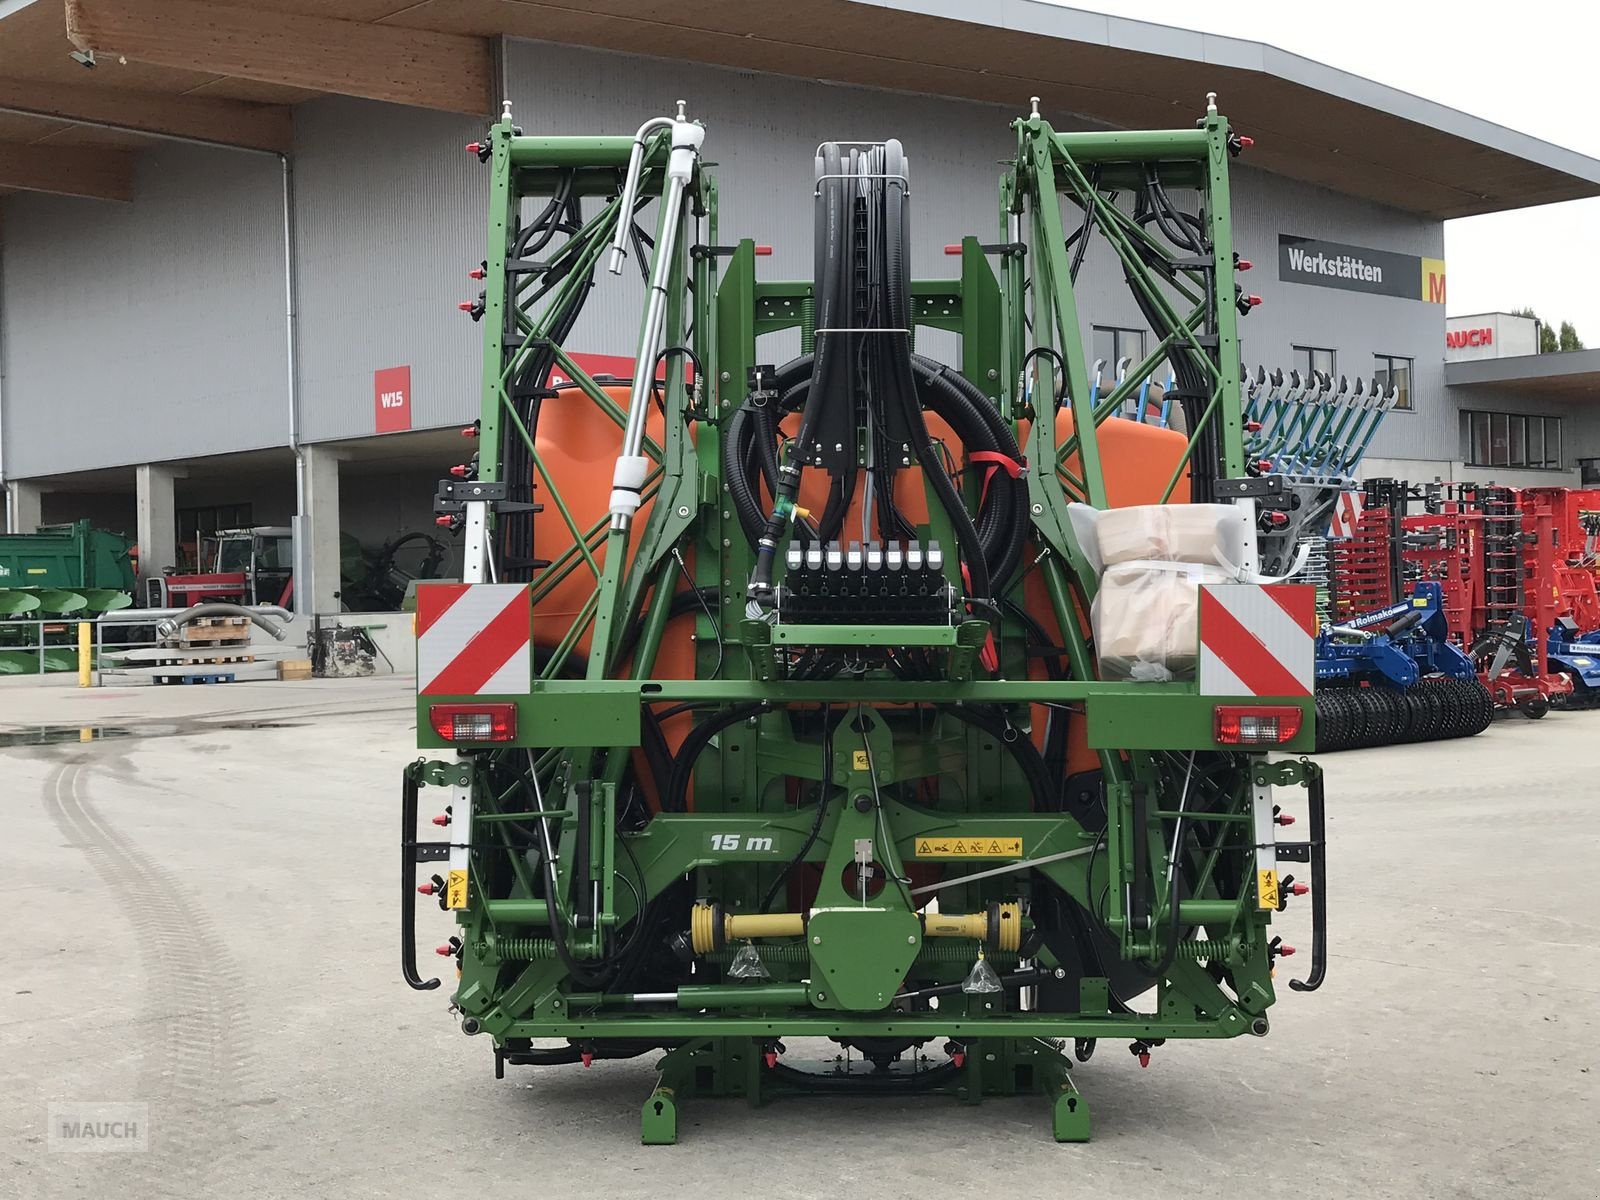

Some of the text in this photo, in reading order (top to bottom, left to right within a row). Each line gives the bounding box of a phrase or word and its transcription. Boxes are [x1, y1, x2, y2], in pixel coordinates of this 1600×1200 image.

[1288, 247, 1382, 282] Werkstätten
[1429, 272, 1446, 304] M
[381, 391, 403, 408] W15
[1356, 608, 1394, 627] Rolmako
[711, 834, 773, 851] 15 m
